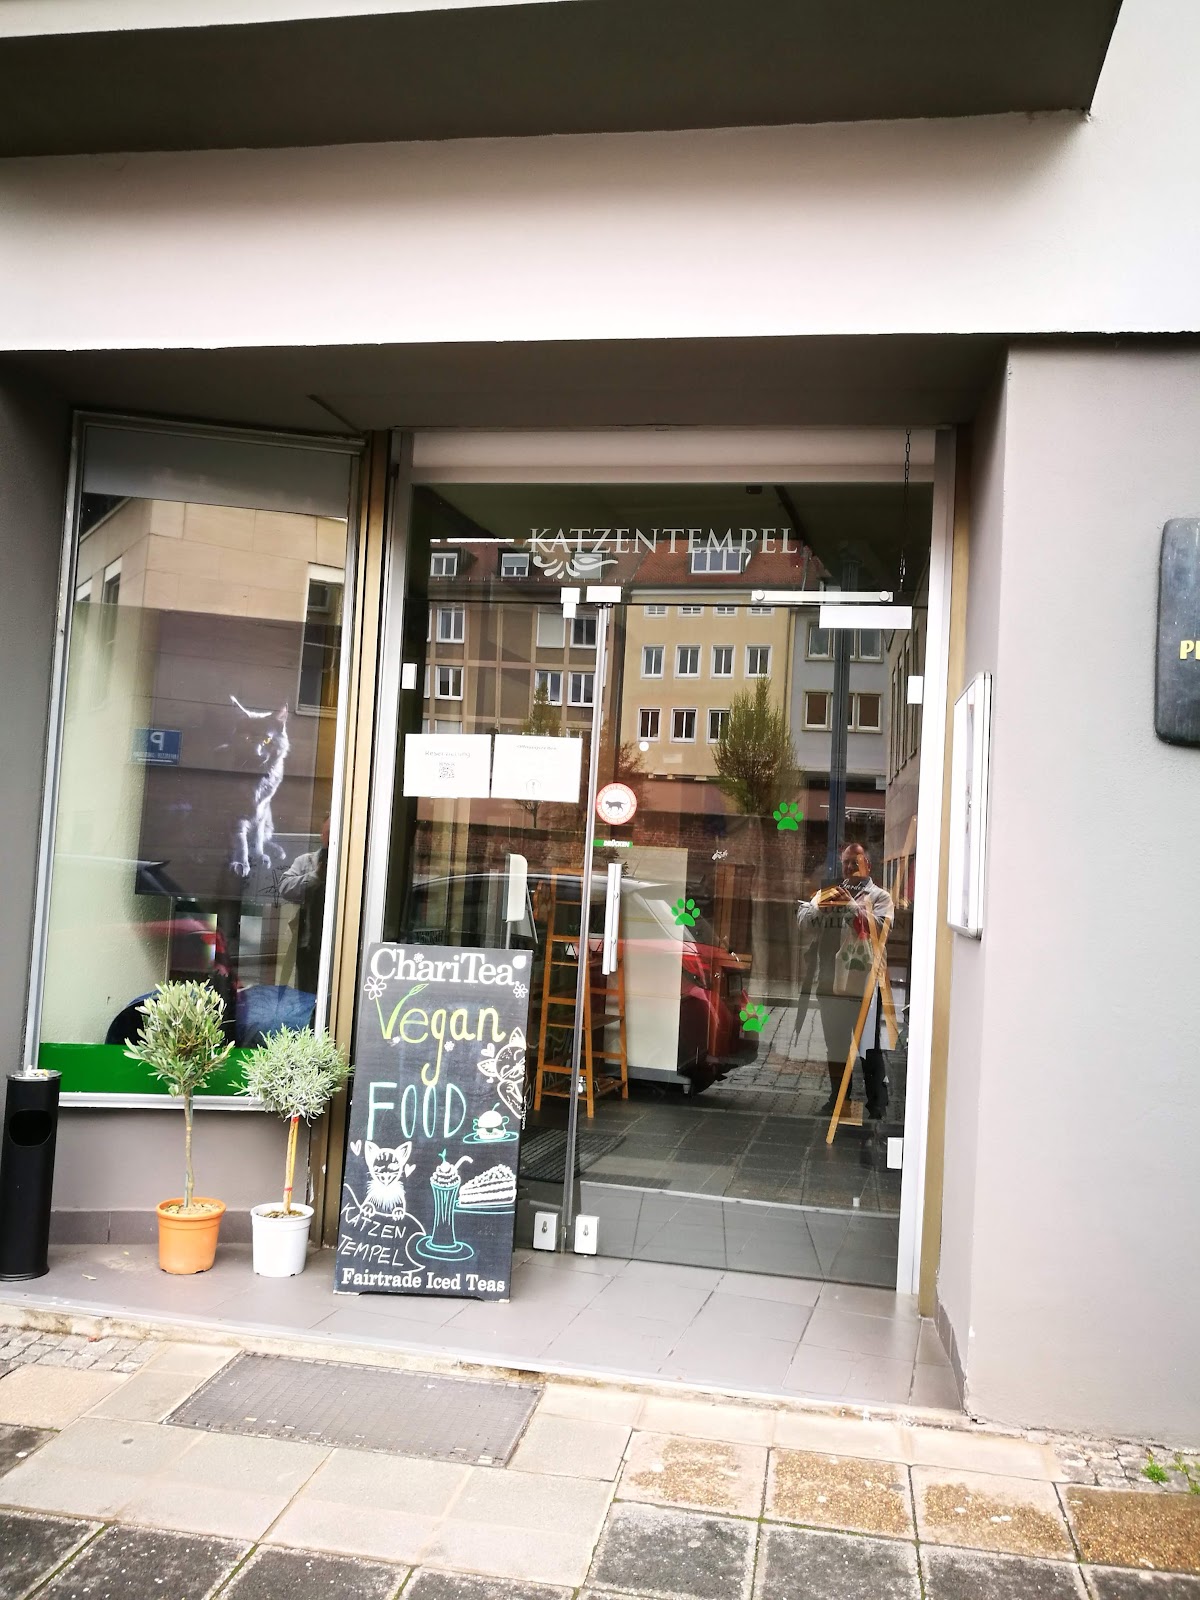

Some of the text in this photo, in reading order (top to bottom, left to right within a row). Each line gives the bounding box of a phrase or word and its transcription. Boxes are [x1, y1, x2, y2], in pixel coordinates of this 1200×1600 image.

[529, 528, 798, 554] KATZENTEMPEL
[370, 948, 515, 986] ChariTea
[375, 983, 506, 1086] Vegan
[366, 1081, 466, 1141] FOOD
[340, 1203, 406, 1239] KATZEN
[337, 1234, 404, 1266] TEMPEL
[341, 1267, 505, 1292] Fairtrade Iced Teas
